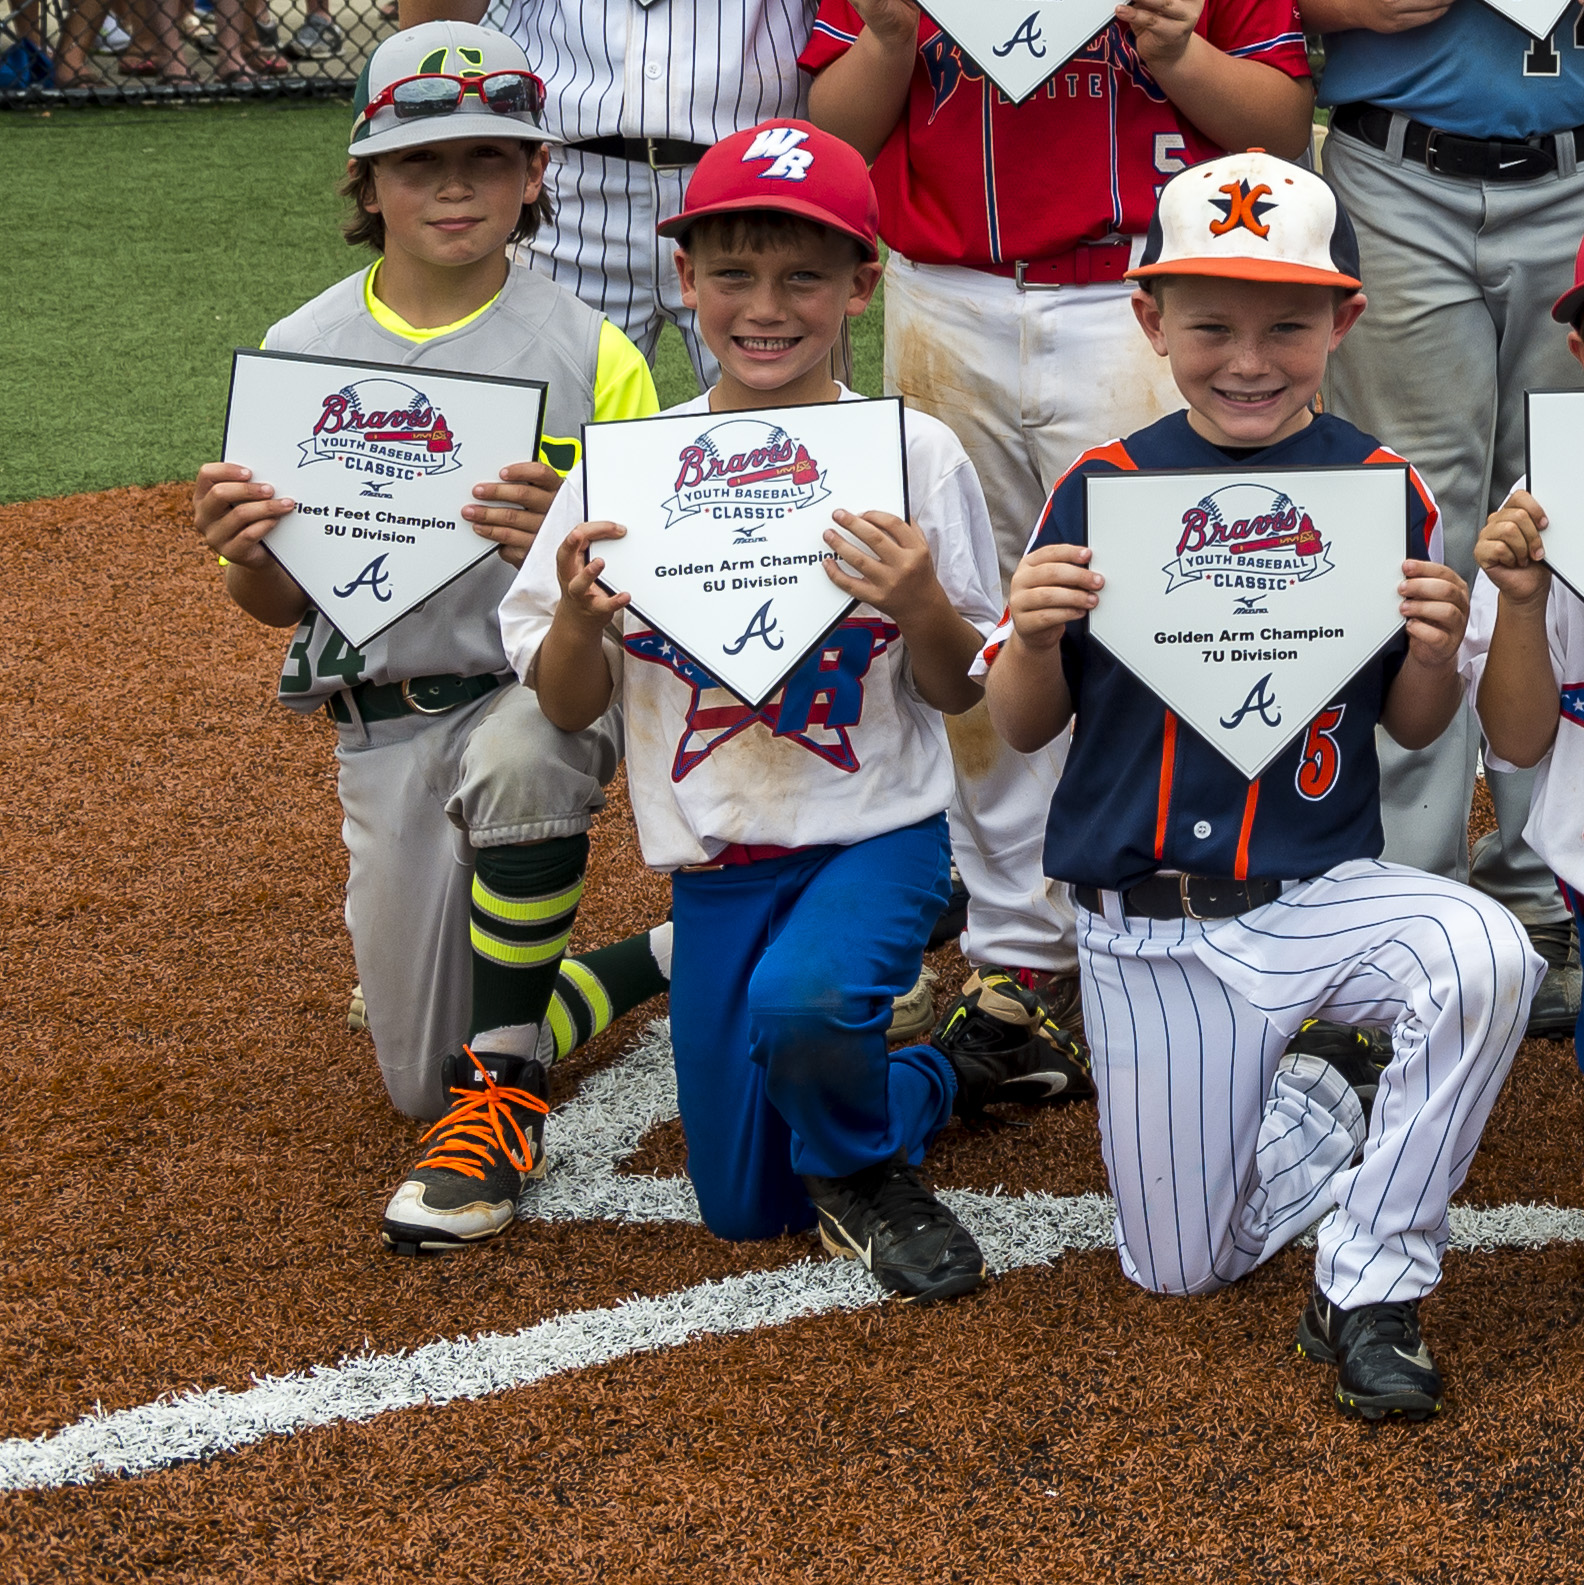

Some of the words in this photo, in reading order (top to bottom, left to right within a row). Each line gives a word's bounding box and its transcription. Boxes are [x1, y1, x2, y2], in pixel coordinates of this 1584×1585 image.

[313, 394, 433, 436] Braves
[345, 457, 414, 480] CLASSIC
[675, 438, 793, 492] Braves
[334, 507, 370, 521] Feet
[375, 511, 456, 531] Champion
[713, 507, 784, 520] CLASSIC
[324, 524, 347, 537] 9U
[351, 527, 416, 545] Division
[1176, 507, 1297, 557] Braves
[654, 563, 714, 578] Golden
[719, 558, 755, 572] Arm
[703, 581, 726, 593] 6U
[732, 574, 798, 590] Division
[1214, 574, 1287, 591] CLASSIC
[1154, 631, 1214, 645] Golden
[1219, 629, 1255, 643] Arm
[1260, 626, 1344, 643] Champion
[1201, 650, 1225, 663] 7U
[1230, 648, 1298, 662] Division
[1295, 703, 1347, 802] 5
